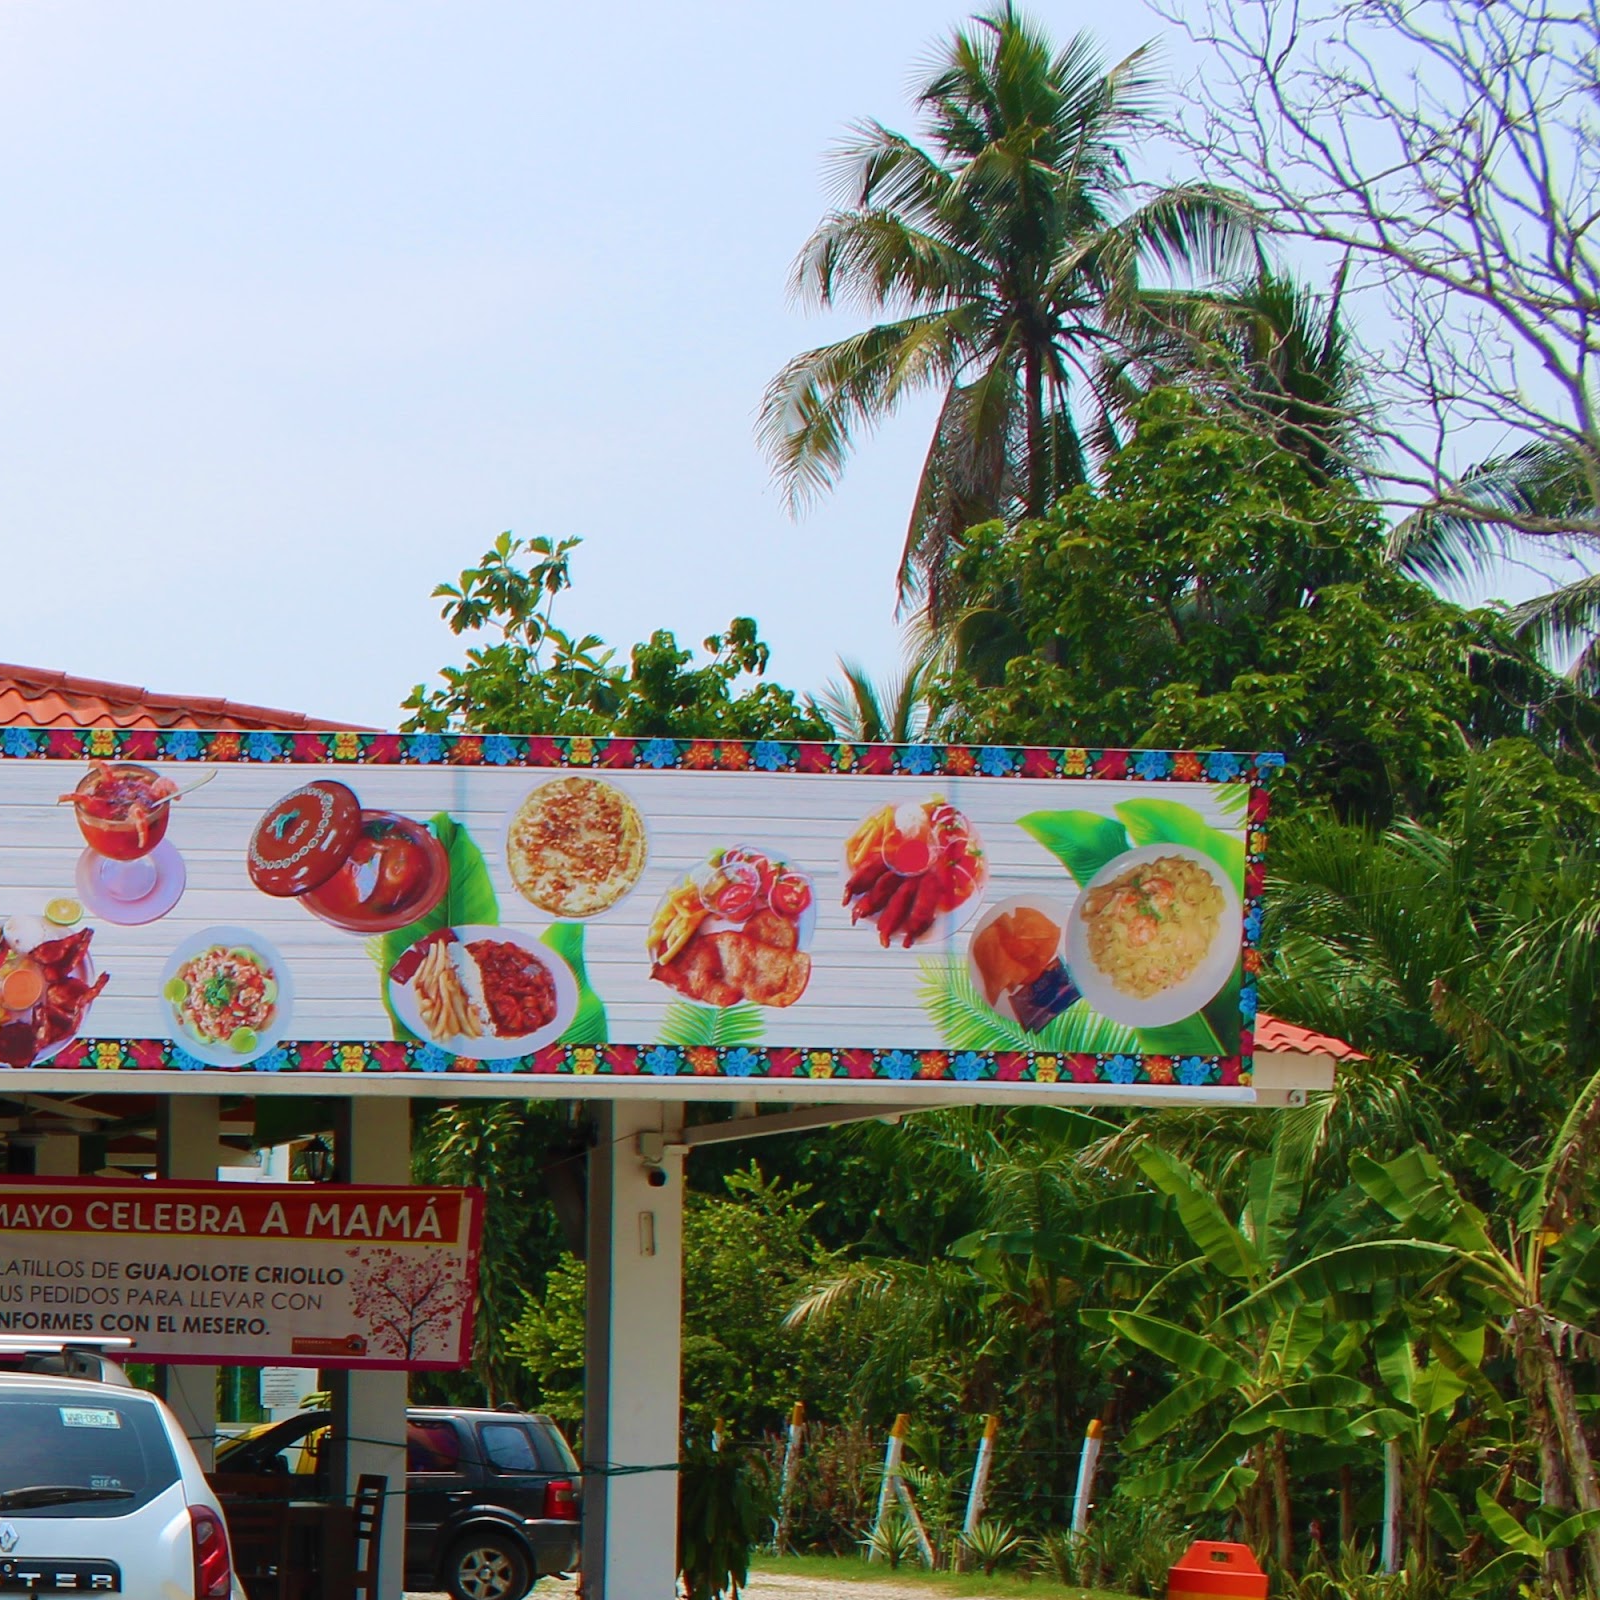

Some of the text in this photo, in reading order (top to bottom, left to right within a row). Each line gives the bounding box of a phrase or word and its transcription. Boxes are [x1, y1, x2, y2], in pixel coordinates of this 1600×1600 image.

[85, 1201, 247, 1233] CELEBRA
[260, 1201, 289, 1235] A
[305, 1196, 442, 1239] MAMÁ
[91, 1261, 119, 1280] DE
[126, 1263, 249, 1283] GUAJOLOTE
[255, 1265, 344, 1285] CRIOLLO
[31, 1285, 120, 1305] PEDIDOS
[127, 1290, 183, 1308] PARA
[190, 1291, 263, 1310] LLEVAR
[271, 1292, 322, 1311] CON
[100, 1314, 149, 1332] CON
[157, 1315, 177, 1333] EL
[183, 1316, 270, 1335] MESERO.
